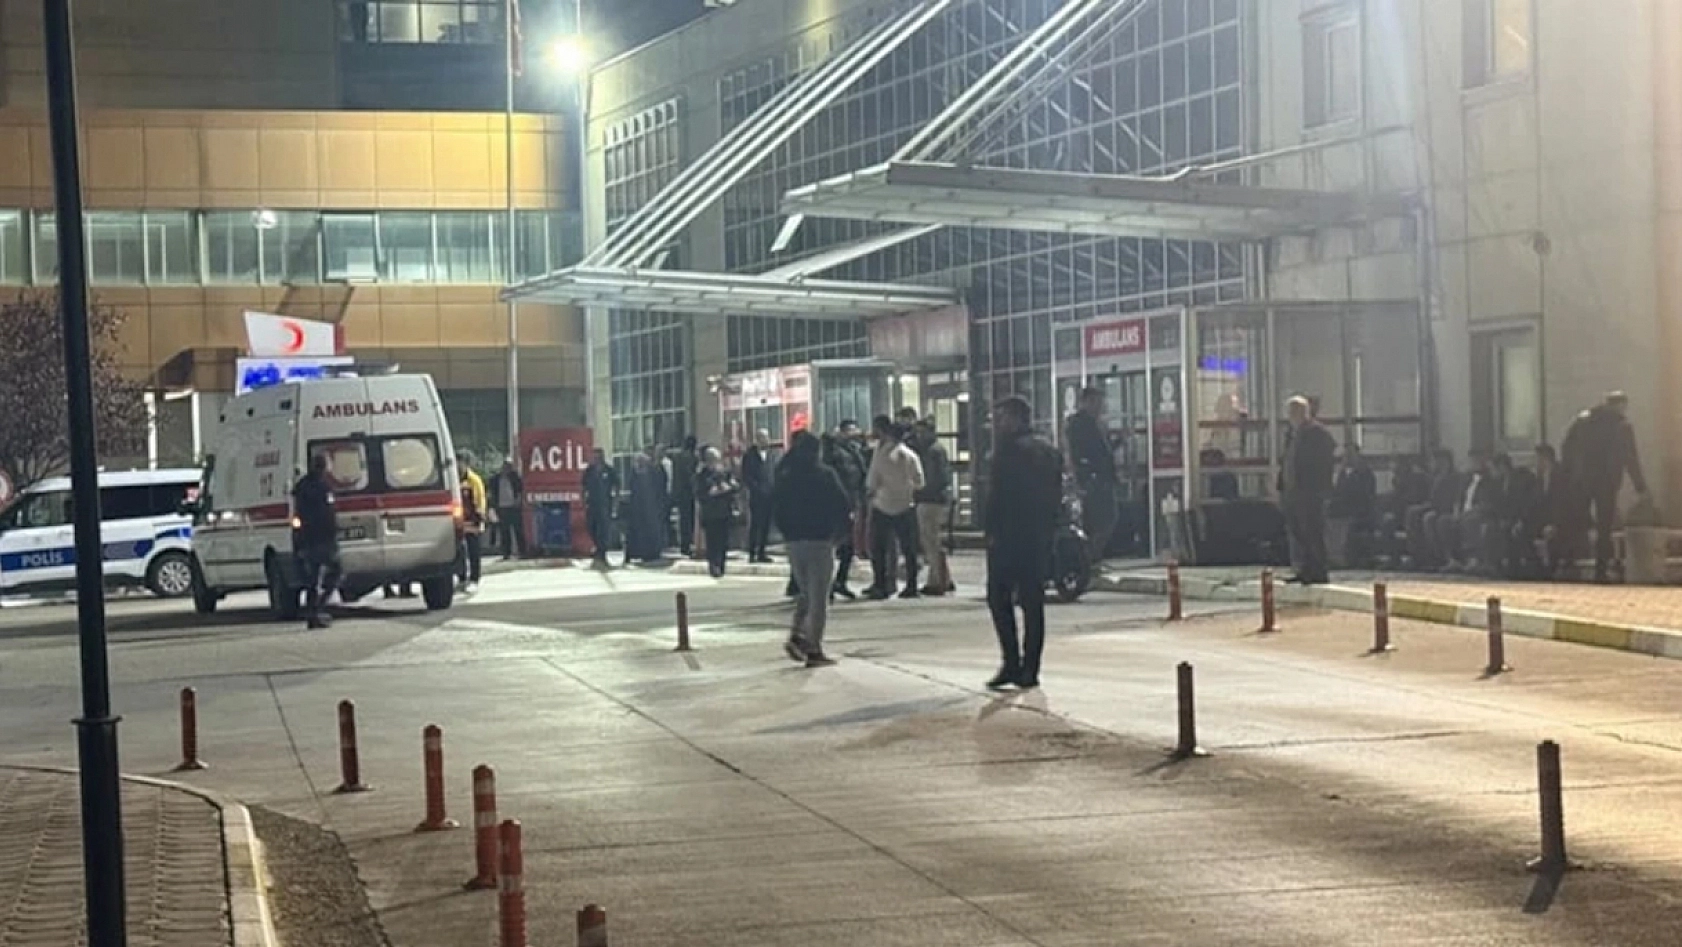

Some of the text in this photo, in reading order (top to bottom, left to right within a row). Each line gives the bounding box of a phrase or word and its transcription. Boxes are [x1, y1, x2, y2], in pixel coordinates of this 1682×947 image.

[1092, 325, 1139, 350] AMBULANS
[312, 399, 419, 418] AMBULANS
[529, 439, 589, 471] ACİL
[21, 550, 64, 566] POLİS
